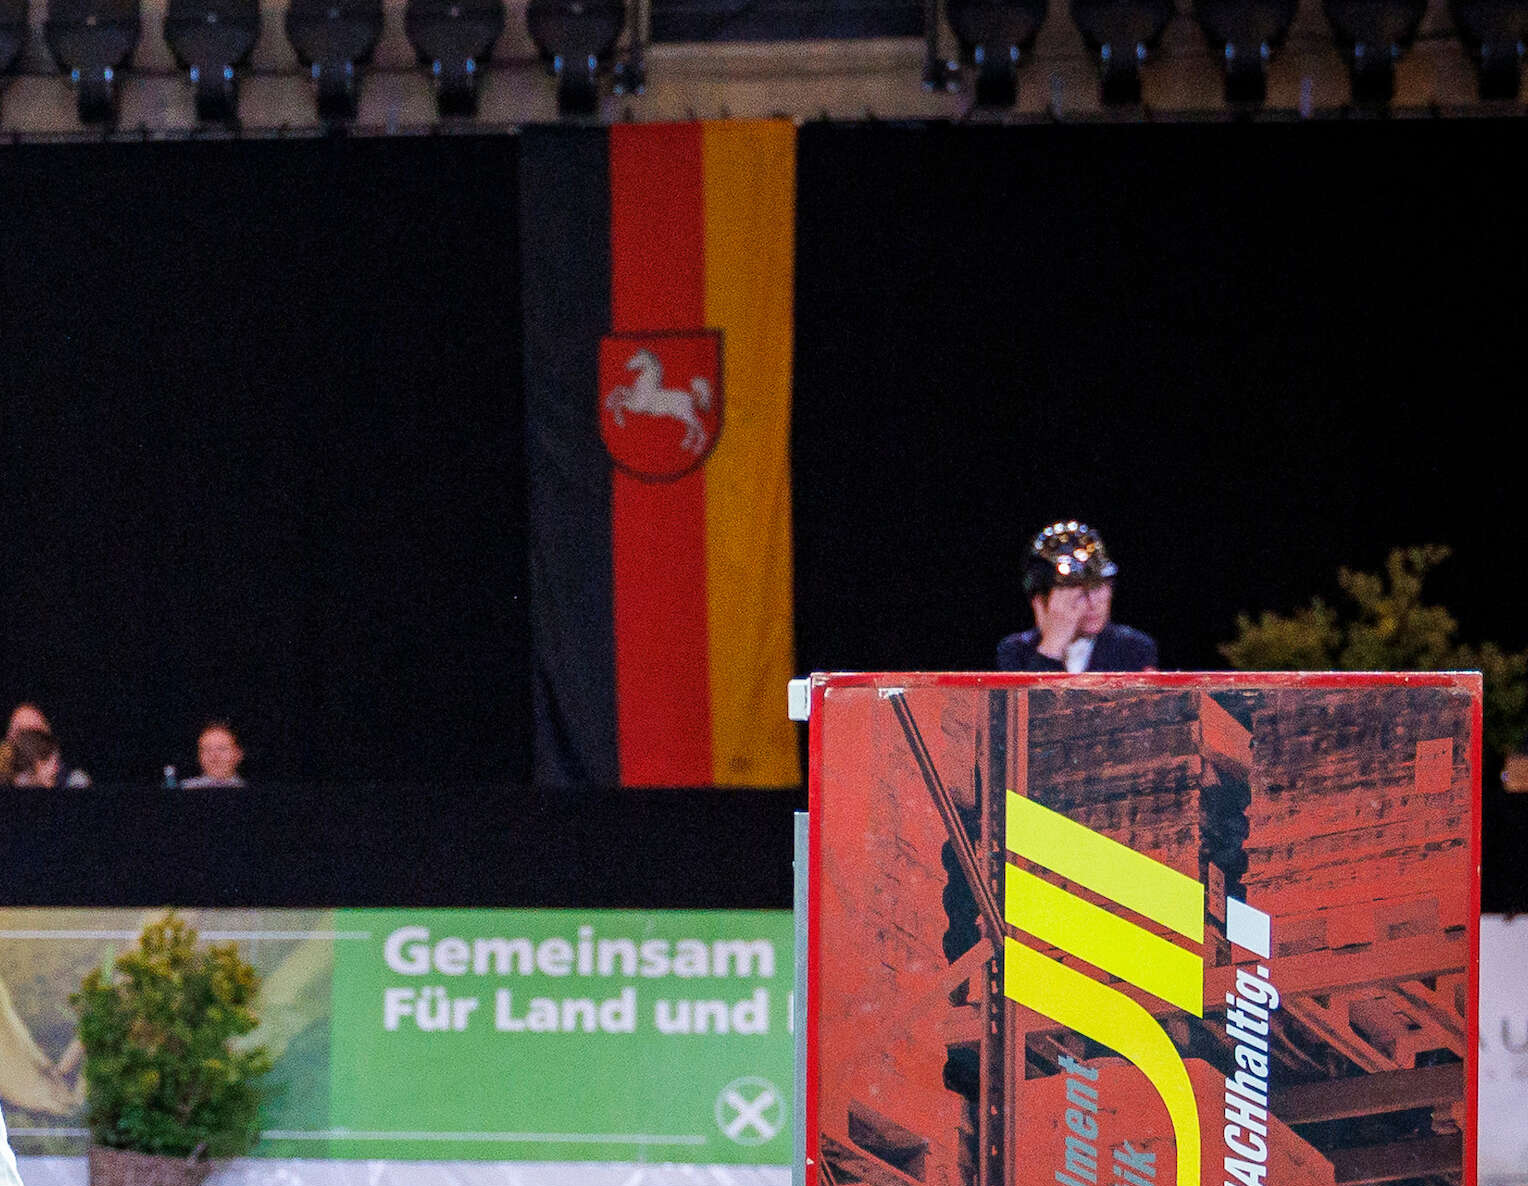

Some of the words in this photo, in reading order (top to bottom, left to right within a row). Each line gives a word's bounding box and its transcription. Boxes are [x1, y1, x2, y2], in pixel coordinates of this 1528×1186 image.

[384, 925, 775, 978] Gemeinsam
[384, 986, 476, 1033] Für
[495, 987, 638, 1034] Land
[655, 988, 770, 1035] und
